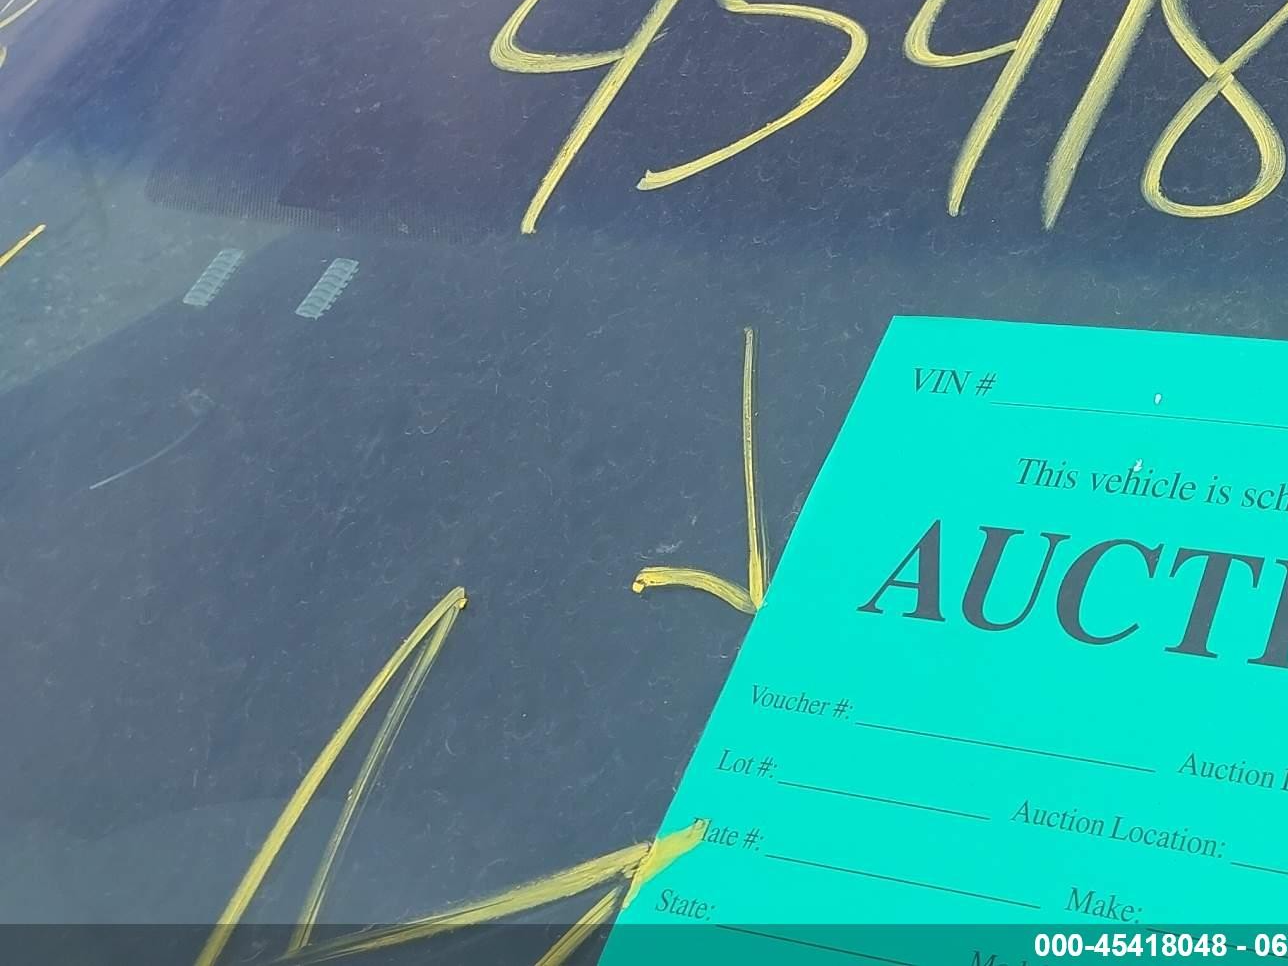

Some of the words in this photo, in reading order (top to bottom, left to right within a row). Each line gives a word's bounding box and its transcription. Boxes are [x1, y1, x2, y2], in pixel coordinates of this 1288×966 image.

[912, 368, 969, 395] VIN
[975, 373, 997, 396] #
[1015, 457, 1078, 490] This
[1089, 467, 1197, 502] vehicle
[1204, 474, 1232, 505] is
[750, 684, 831, 717] Voucher
[832, 697, 854, 720] #:
[716, 748, 755, 775] Lot
[757, 755, 778, 779] #:
[1178, 752, 1275, 790] Auction
[1010, 799, 1103, 837] Auction
[1110, 815, 1227, 859] Location:
[655, 888, 716, 922] State:
[1064, 887, 1144, 925] Make:
